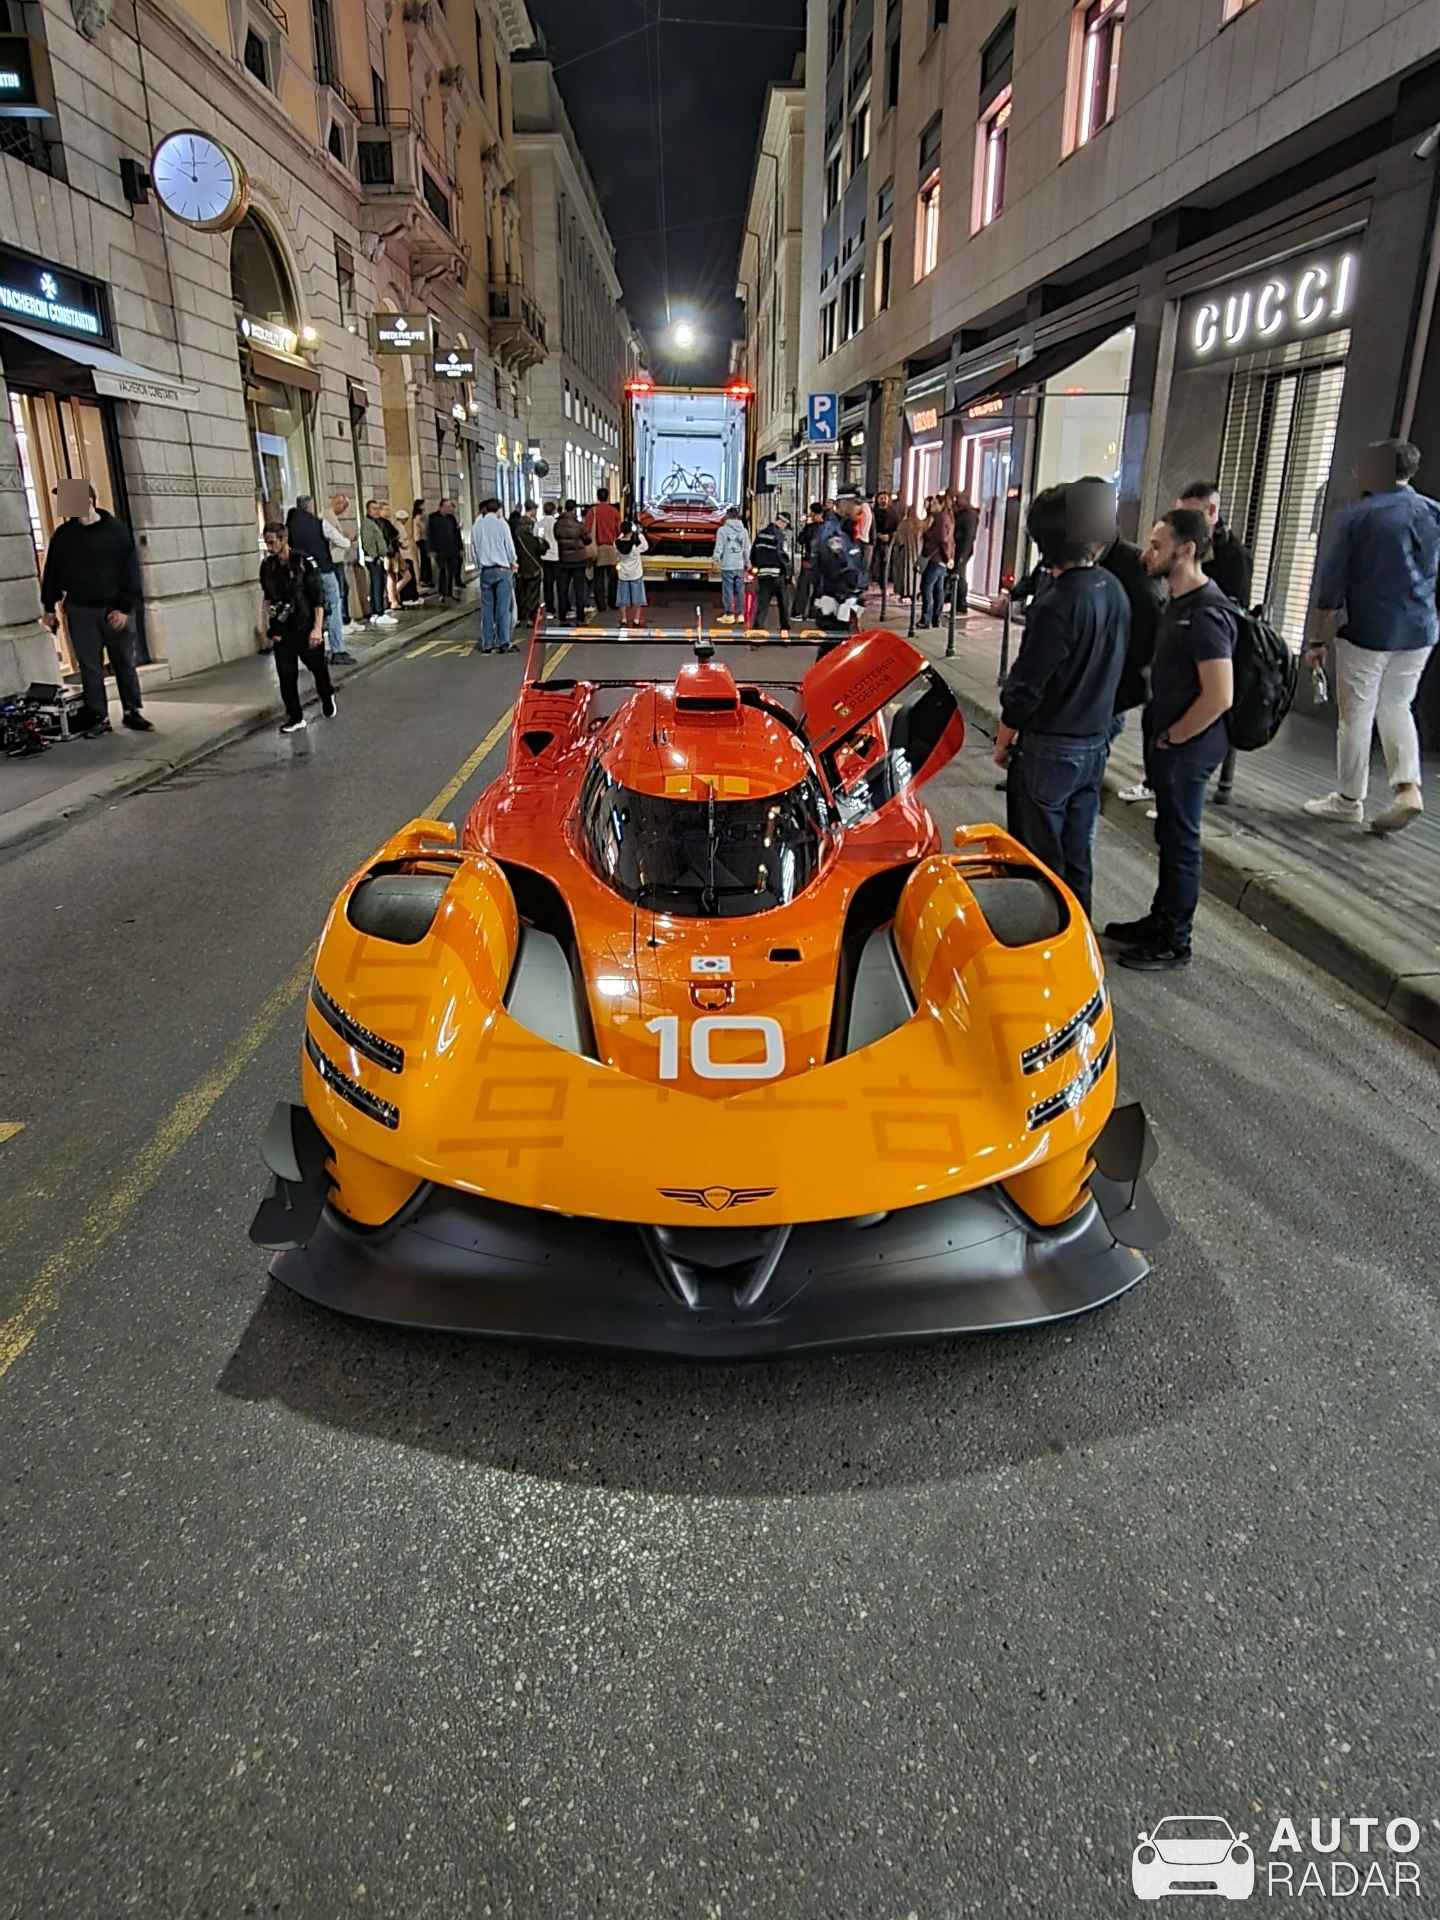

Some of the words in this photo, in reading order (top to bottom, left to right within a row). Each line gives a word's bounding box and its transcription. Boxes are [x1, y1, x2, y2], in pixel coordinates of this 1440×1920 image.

[0, 286, 49, 319] VACHERON
[48, 303, 98, 334] CONSTANTIN
[1195, 256, 1351, 352] GUCCI
[118, 379, 148, 396] VACHERON
[814, 396, 831, 420] P
[645, 1015, 785, 1080] 10
